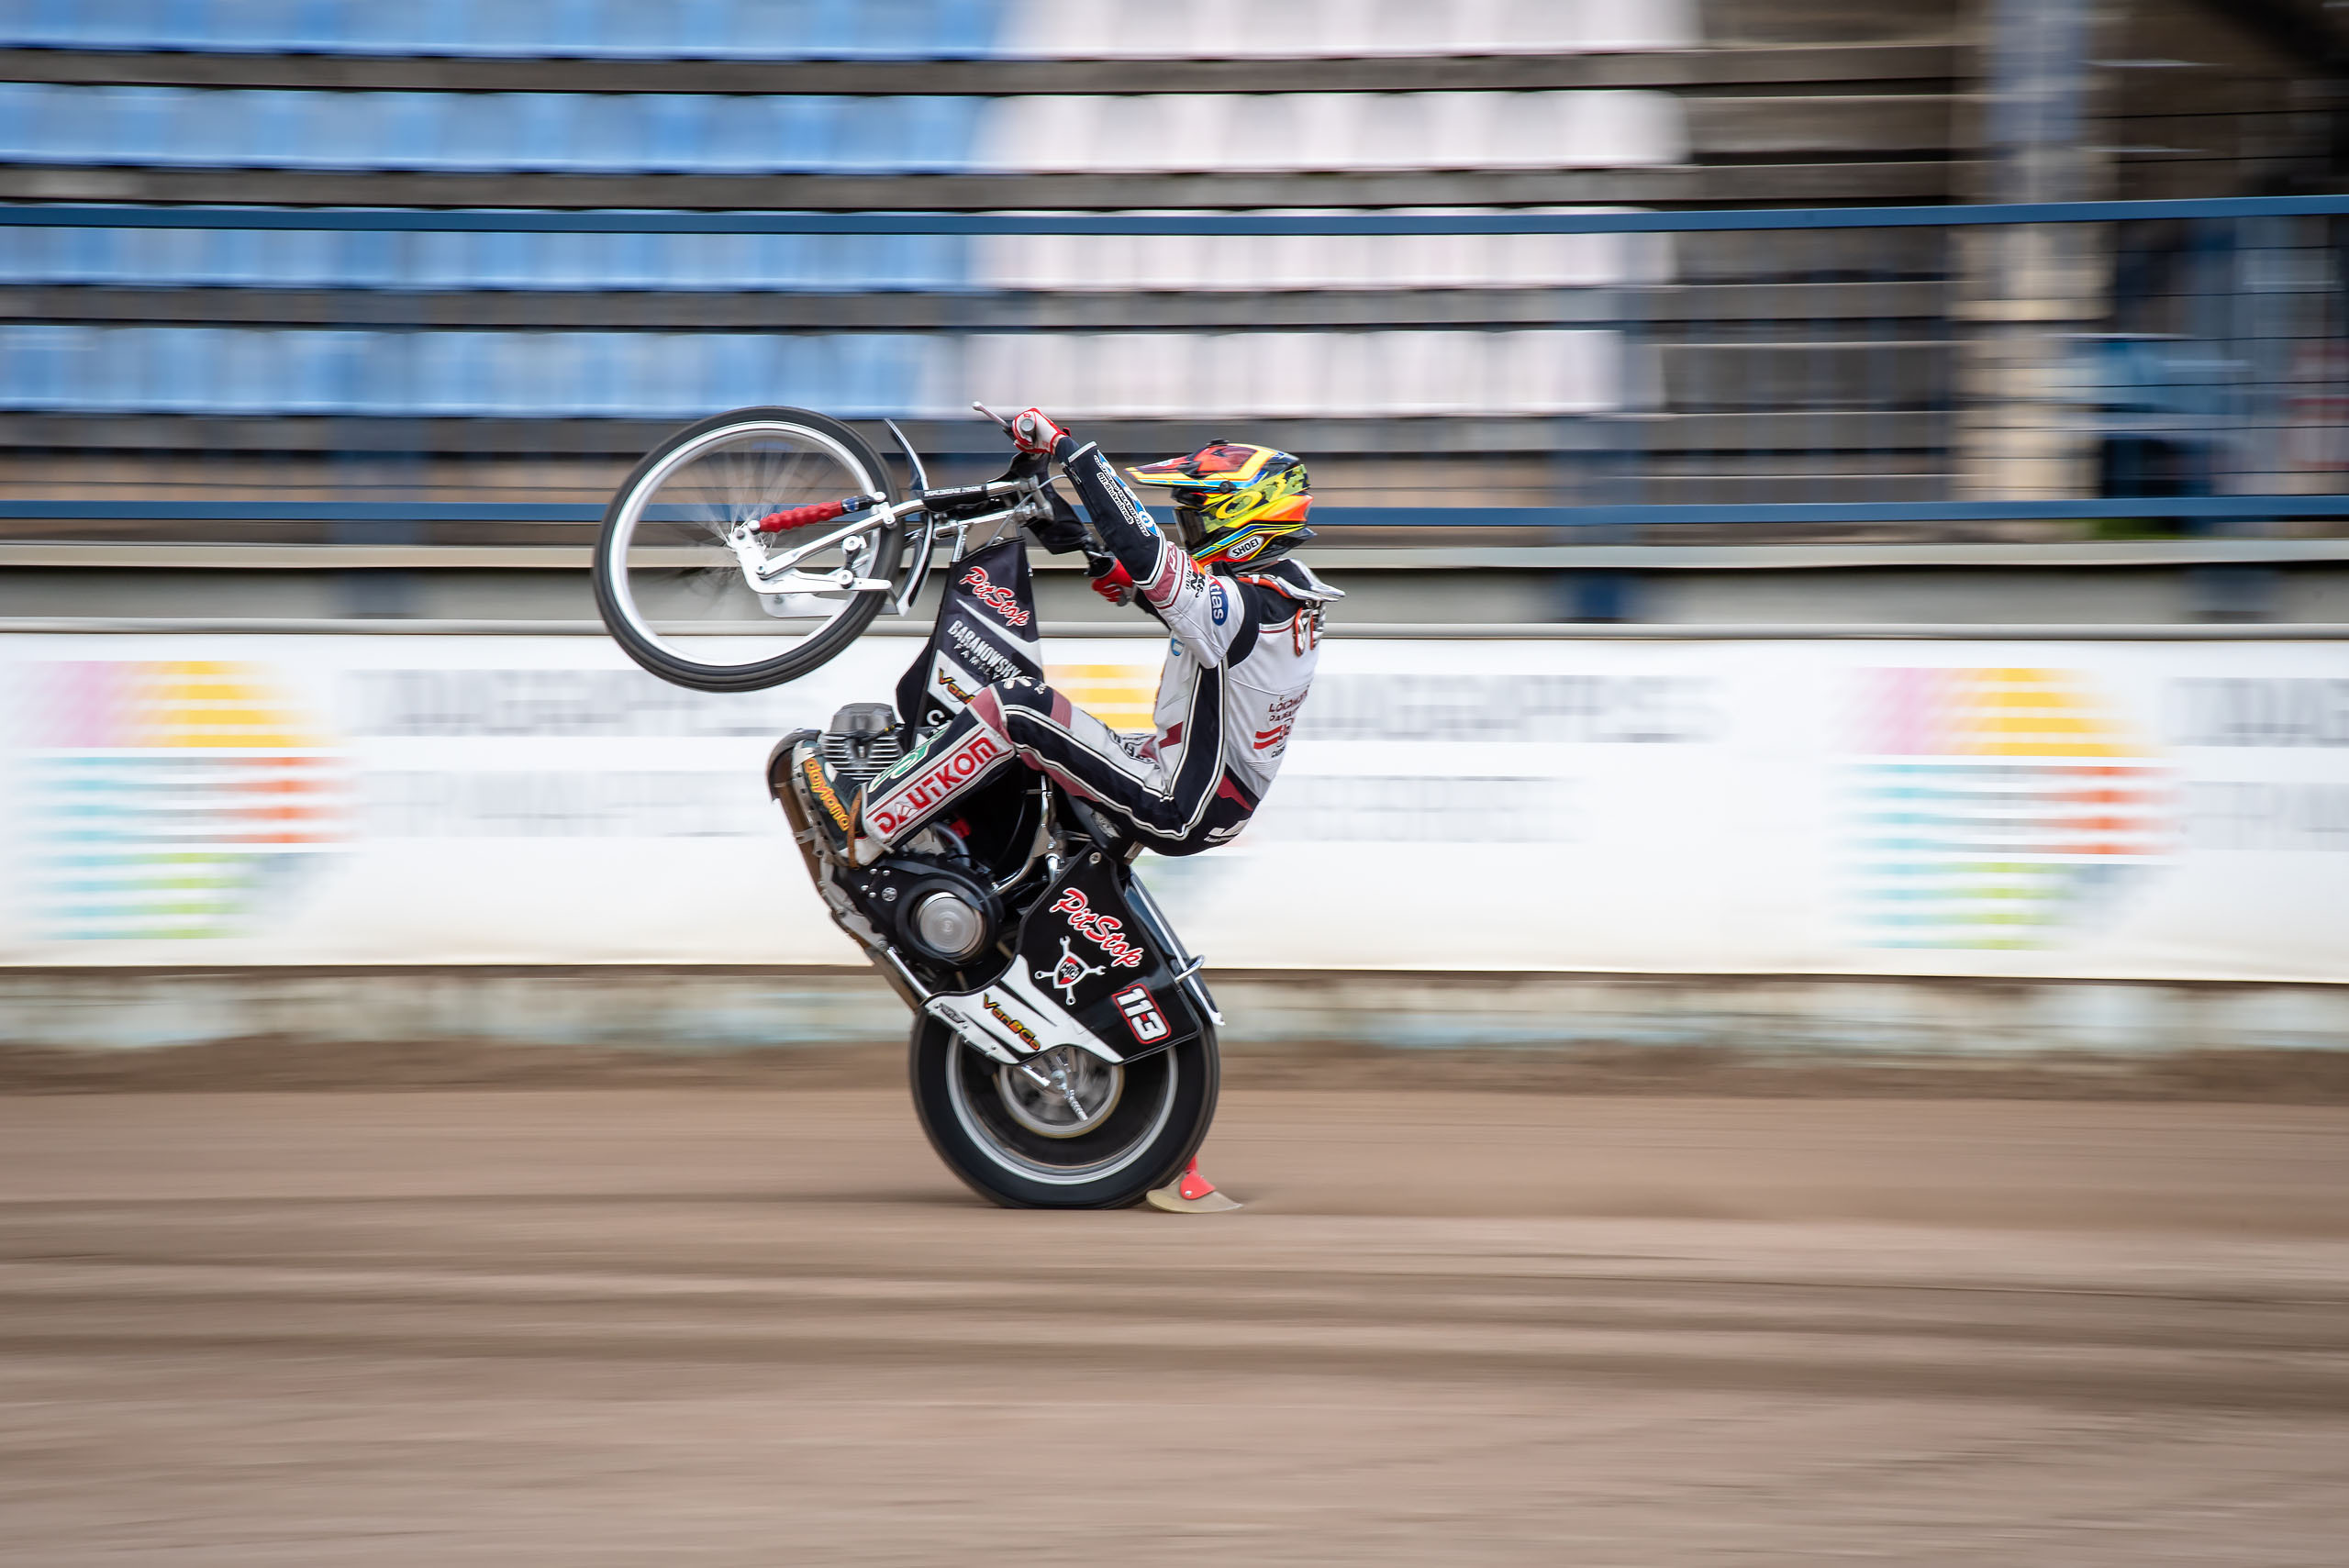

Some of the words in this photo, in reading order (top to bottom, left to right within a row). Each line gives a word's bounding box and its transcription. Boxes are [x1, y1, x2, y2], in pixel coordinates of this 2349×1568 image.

[1232, 539, 1259, 557] SHOEI
[959, 566, 1030, 626] PitStop
[954, 646, 1000, 680] FAMILY
[804, 758, 850, 831] daytona
[874, 737, 998, 834] DAUTKOM
[1049, 887, 1144, 967] PitStop
[1117, 987, 1168, 1040] 113
